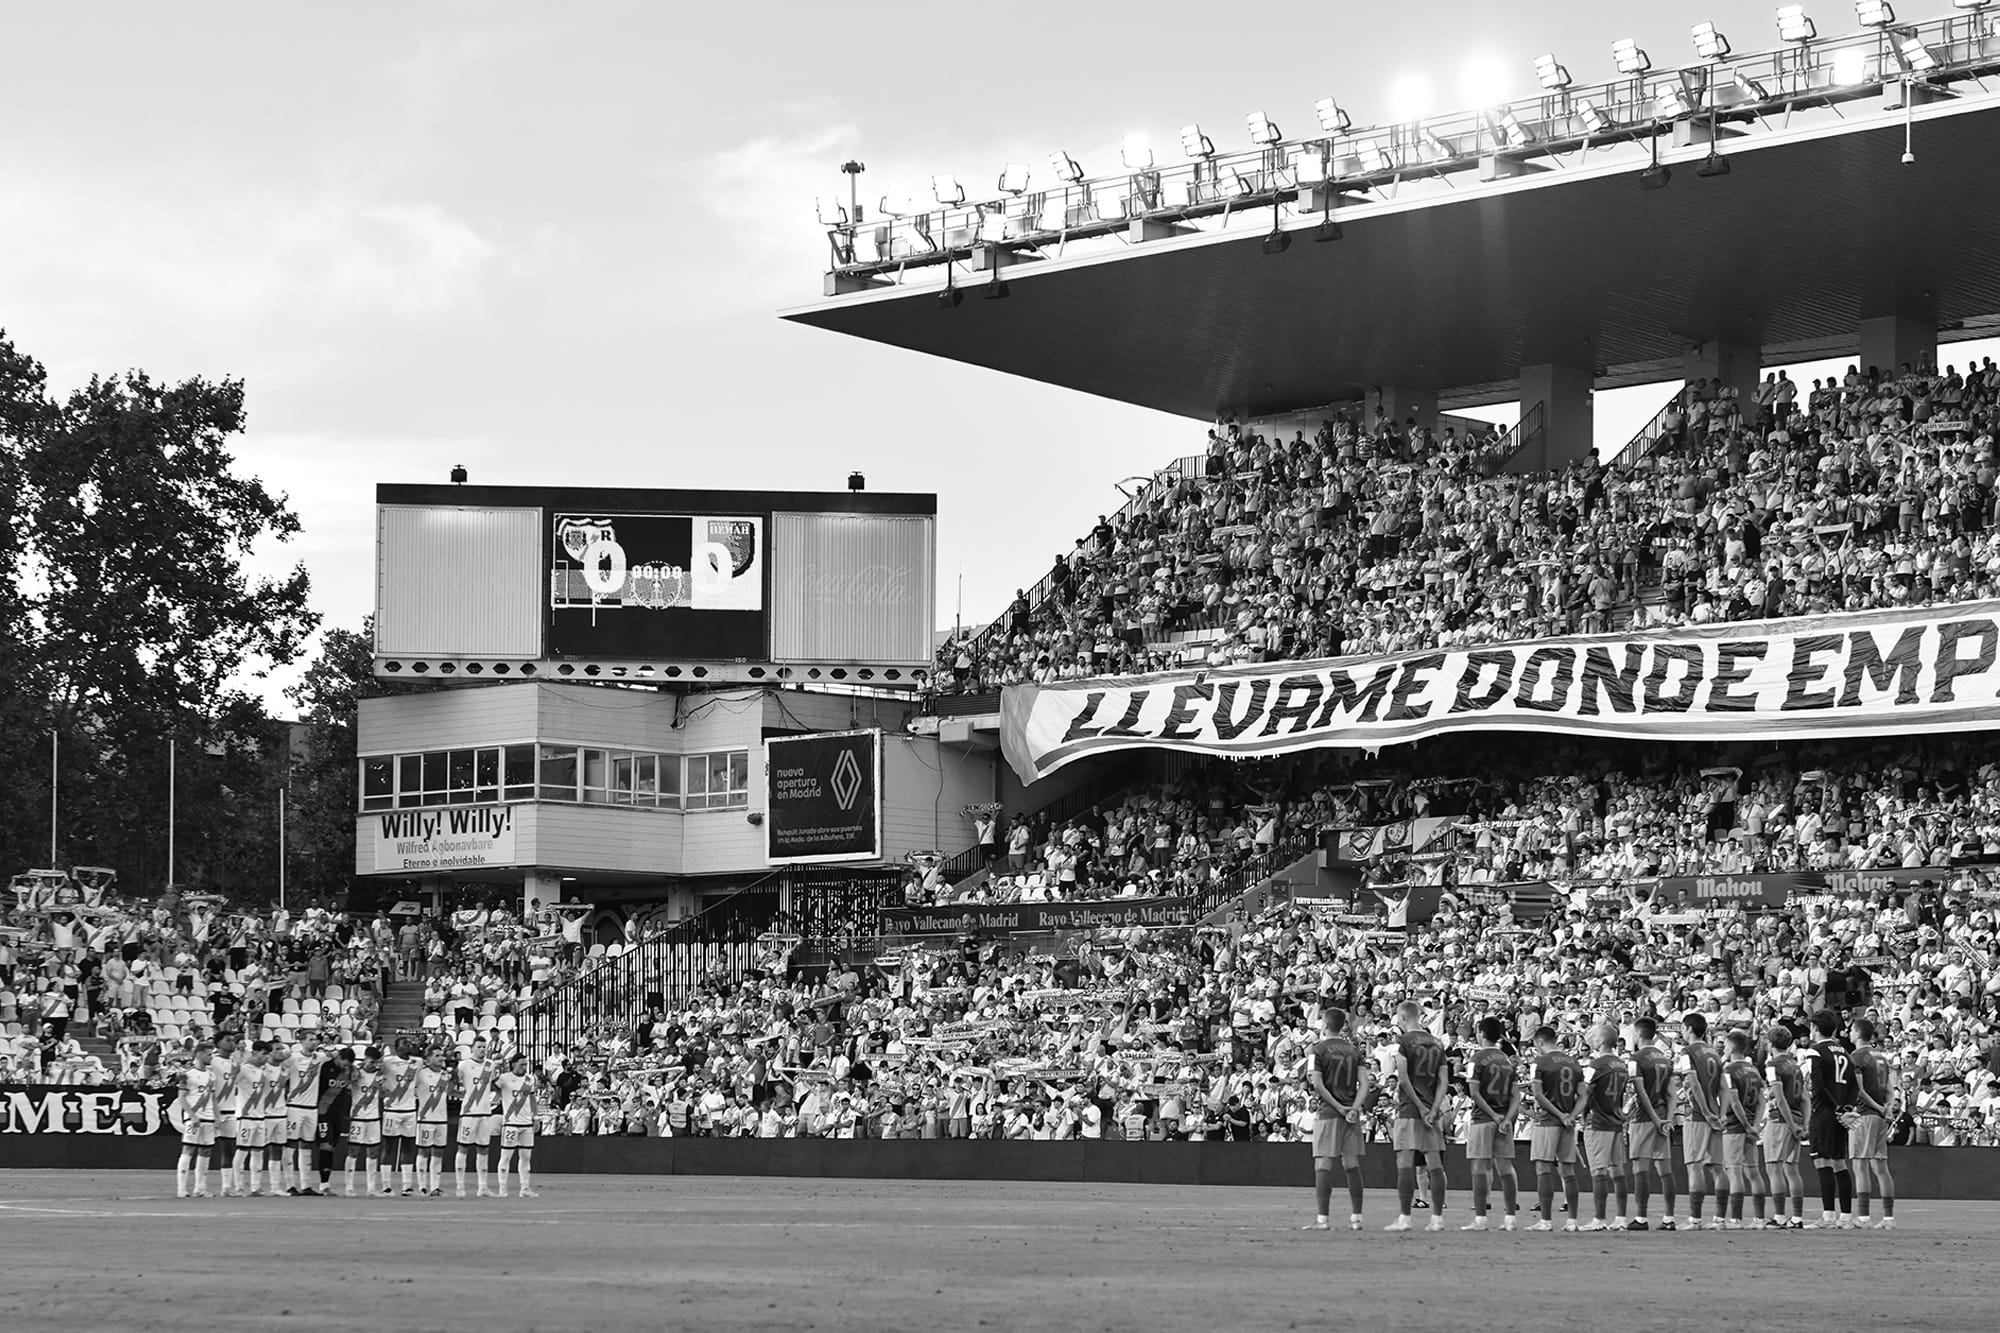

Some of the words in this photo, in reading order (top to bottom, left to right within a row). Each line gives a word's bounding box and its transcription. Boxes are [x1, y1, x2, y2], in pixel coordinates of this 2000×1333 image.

[583, 540, 627, 594] 0
[1448, 641, 1769, 715] DONDE
[1780, 619, 2000, 711] EMP
[777, 768, 804, 777] nueva
[777, 778, 817, 790] apertura
[777, 790, 788, 799] en
[790, 787, 821, 798] Madrid
[382, 811, 441, 842] Willy!
[449, 807, 511, 838] Willy!
[397, 841, 429, 854] Wilfred
[403, 858, 430, 868] Eterno
[440, 855, 486, 866] inolvidable
[1696, 879, 1762, 897] Mahou
[913, 915, 961, 930] Vallecano
[979, 912, 1018, 927] Madrid
[1039, 911, 1066, 927] Rayo
[1124, 909, 1137, 923] de
[1141, 907, 1189, 923] Madrid
[1415, 1046, 1441, 1077] 20
[1834, 1054, 1848, 1084] 12
[1487, 1064, 1512, 1095] 27
[1560, 1066, 1573, 1096] 8
[350, 1126, 361, 1136] 23
[385, 1119, 393, 1129] 11
[462, 1126, 471, 1136] 15
[505, 1131, 515, 1140] 22
